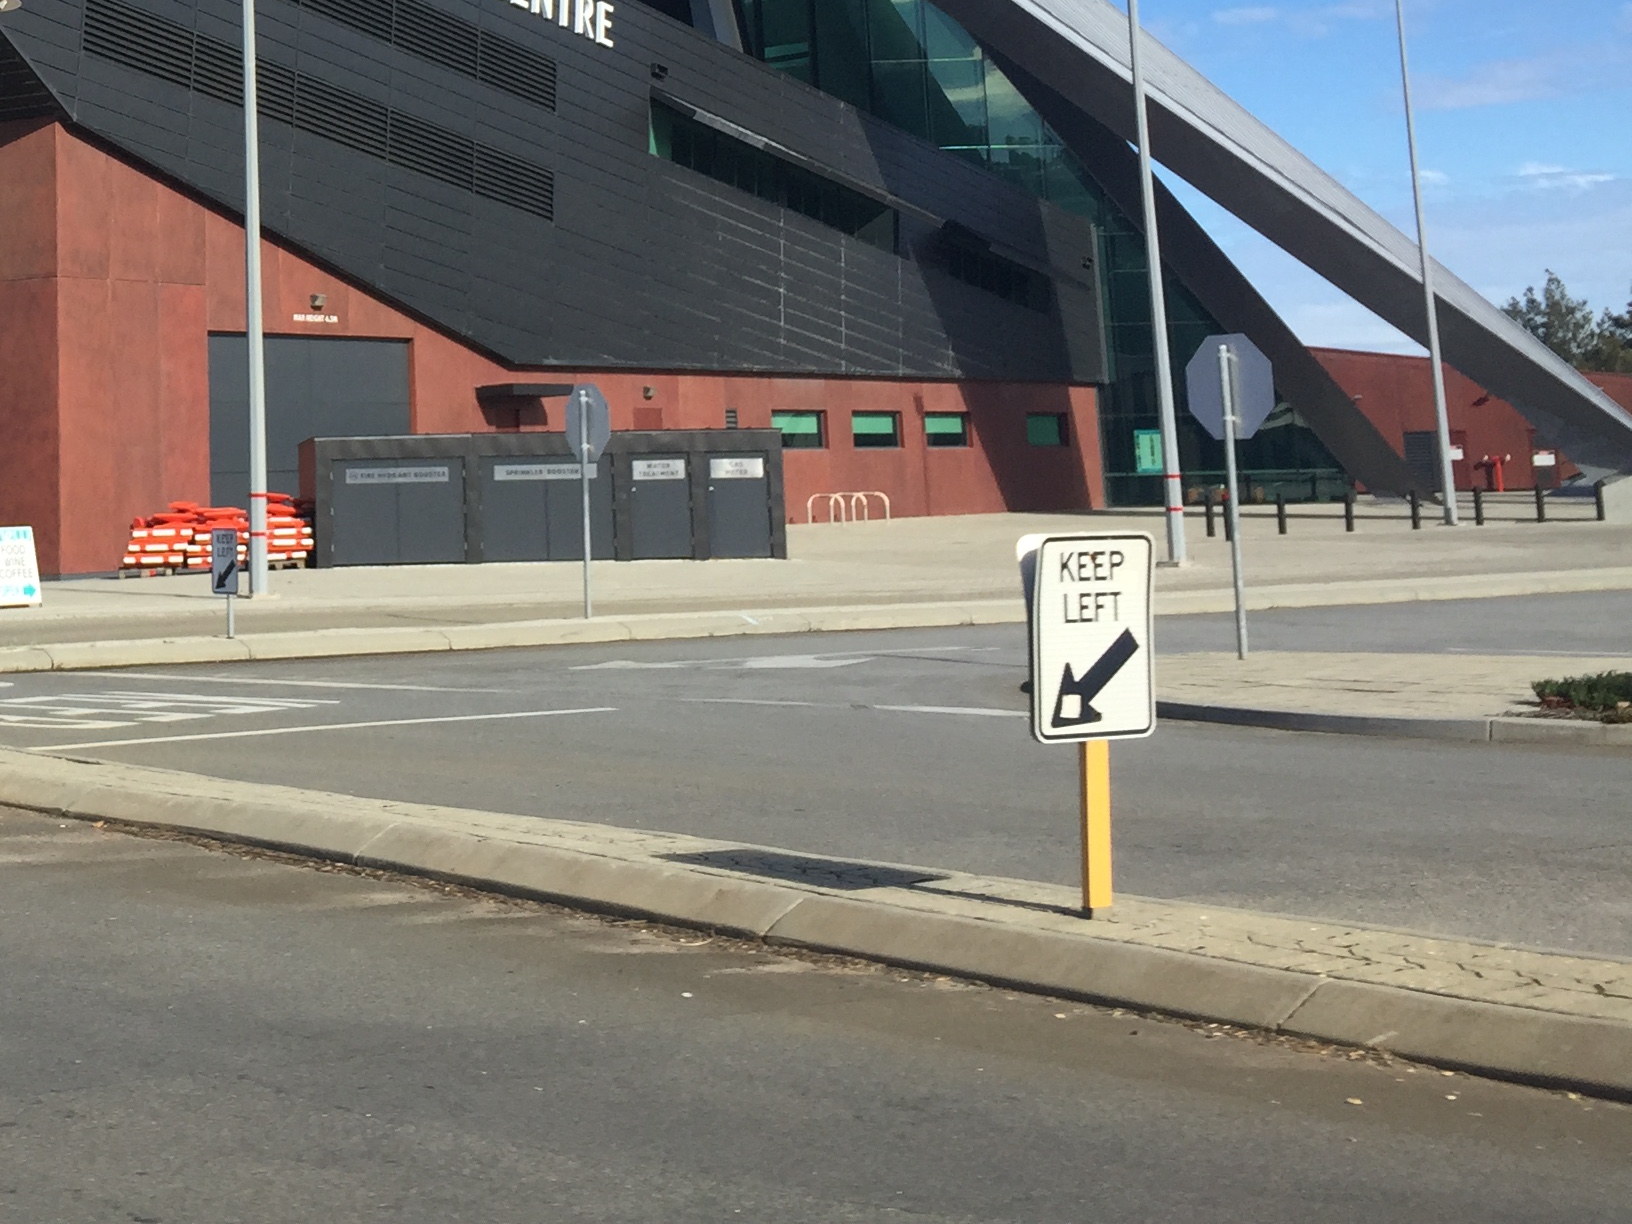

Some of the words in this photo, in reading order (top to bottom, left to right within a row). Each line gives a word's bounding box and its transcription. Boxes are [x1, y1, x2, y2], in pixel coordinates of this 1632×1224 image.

[216, 533, 234, 545] KEEP
[1, 544, 26, 556] FOOD
[216, 546, 234, 558] LEFT
[4, 556, 26, 567] WINE
[1060, 550, 1125, 582] KEEP
[0, 567, 33, 580] COFFEE
[1064, 591, 1122, 623] LEFT
